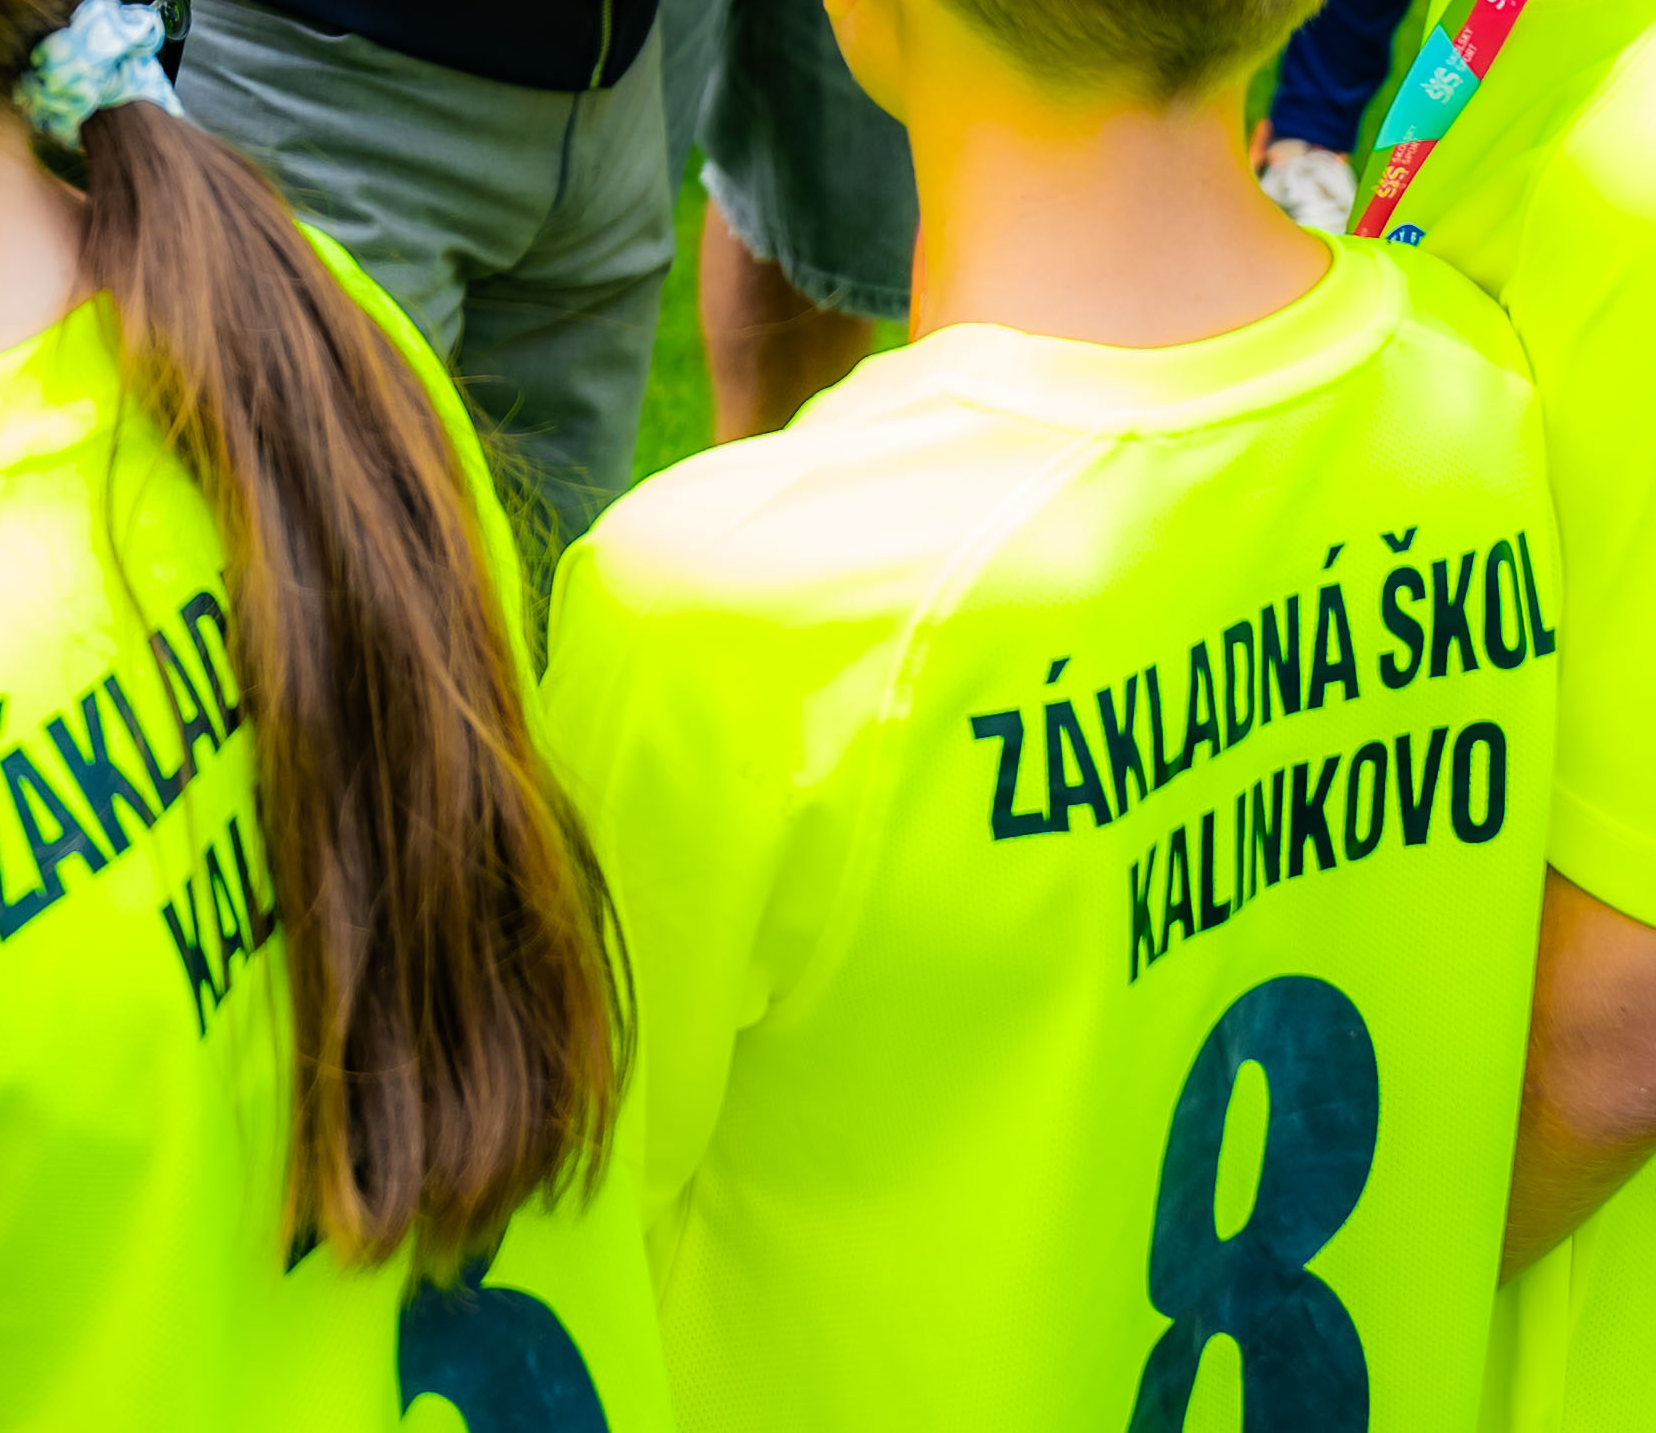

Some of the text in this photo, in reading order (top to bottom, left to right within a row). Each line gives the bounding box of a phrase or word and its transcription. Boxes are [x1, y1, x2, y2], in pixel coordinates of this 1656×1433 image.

[970, 526, 1558, 842] ZÁKLADNÁ ŠKOL
[1128, 719, 1509, 984] KALINKOVO
